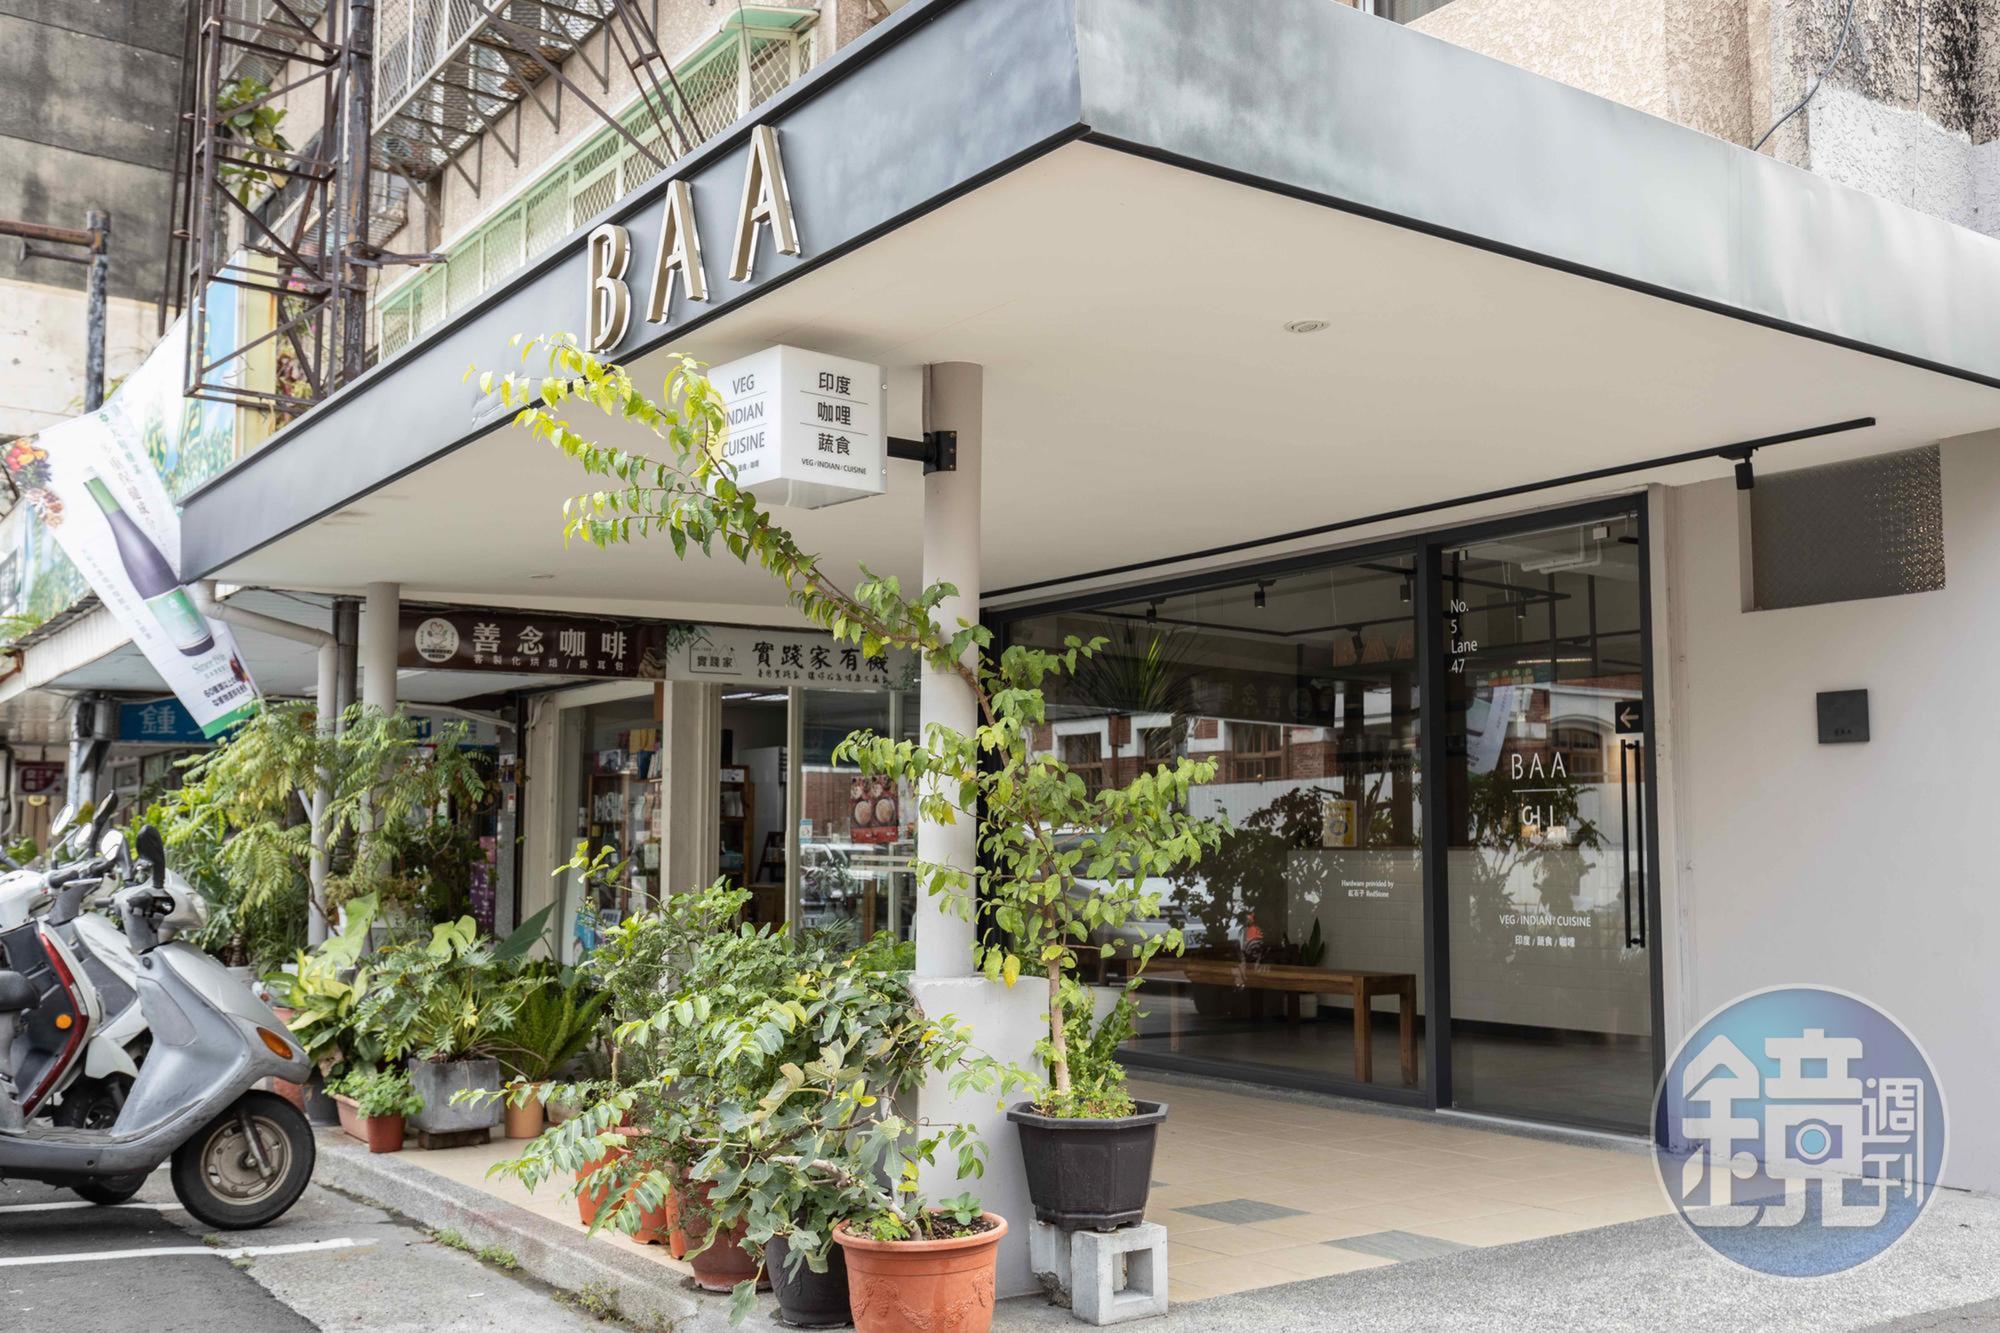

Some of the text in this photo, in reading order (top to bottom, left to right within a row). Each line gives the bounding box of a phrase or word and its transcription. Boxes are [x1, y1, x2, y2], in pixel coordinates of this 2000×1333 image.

[585, 123, 801, 354] BAA
[732, 373, 755, 395] VEG
[818, 371, 851, 396] 印度
[817, 401, 851, 426] 咖哩
[721, 431, 765, 458] CUISINE
[818, 432, 851, 456] 蔬食
[801, 458, 866, 474] VEG INDIAN CUISINE
[1450, 599, 1469, 613] No.
[1450, 619, 1458, 634] 5
[473, 623, 627, 660] 善念咖啡
[1451, 639, 1478, 654] Lane
[1451, 658, 1465, 673] 47
[1511, 751, 1567, 780] BAA
[1365, 880, 1386, 888] provided
[1387, 880, 1394, 889] by
[1499, 914, 1591, 927] VEG INDIAN CUISINE
